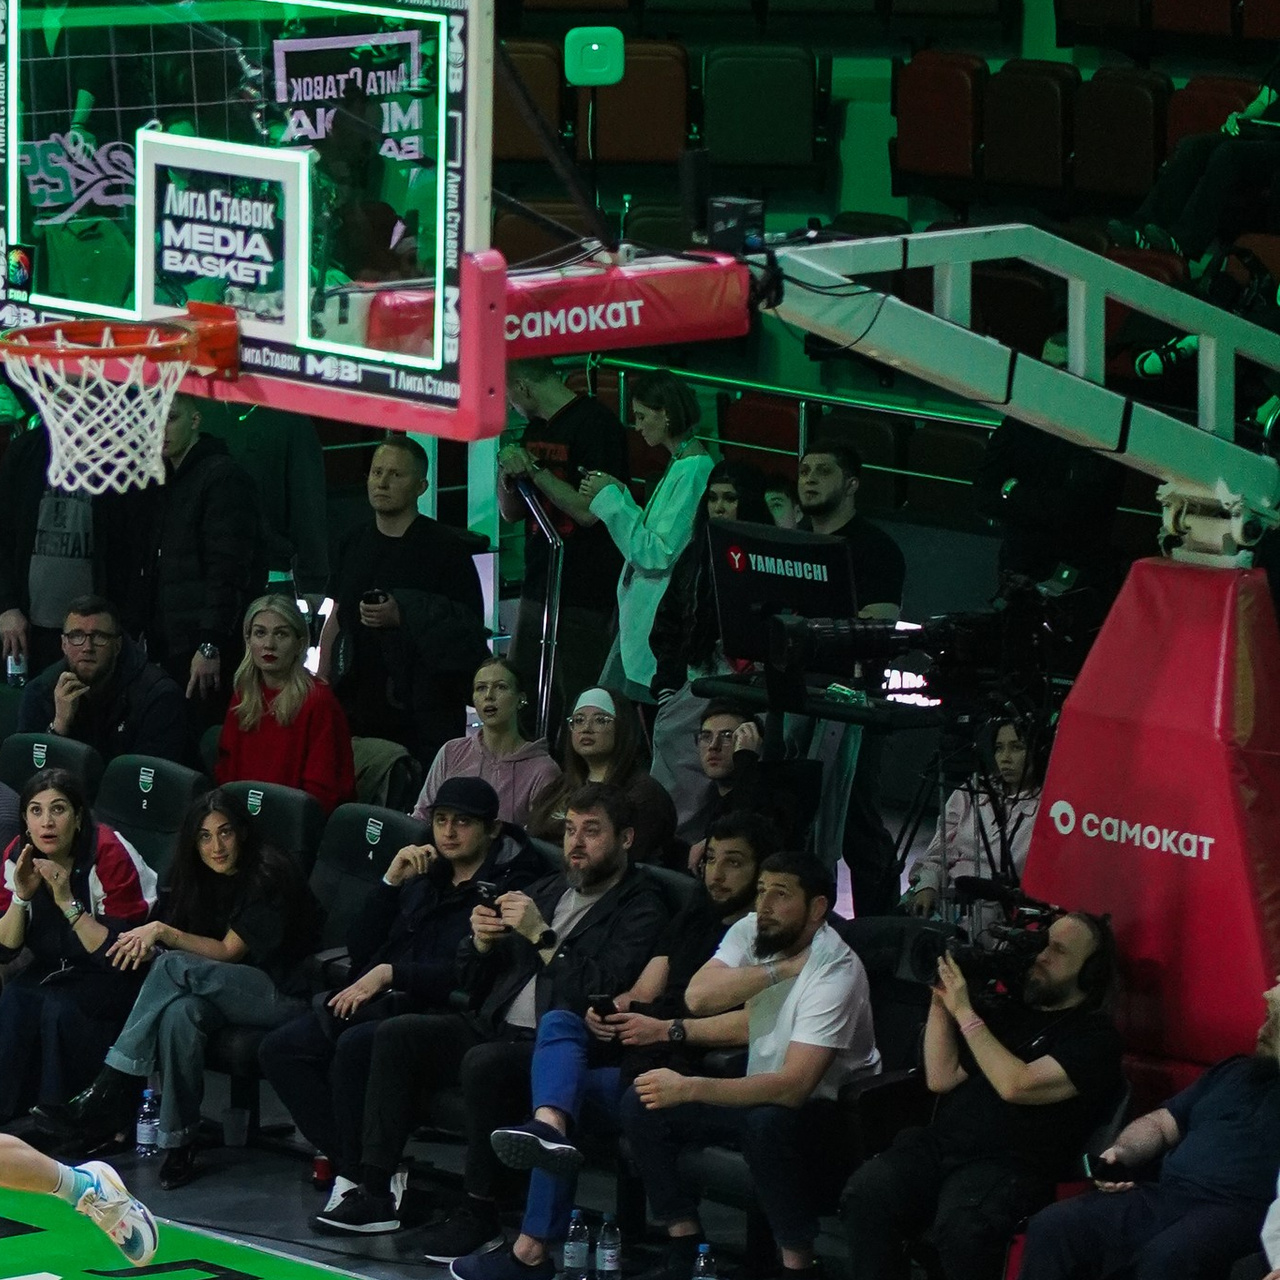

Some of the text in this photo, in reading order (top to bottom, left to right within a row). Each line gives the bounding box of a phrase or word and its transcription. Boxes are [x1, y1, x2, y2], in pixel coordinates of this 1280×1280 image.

[163, 220, 274, 262] MEDIA
[162, 249, 274, 286] BASKET
[504, 299, 645, 341] самокат
[425, 375, 461, 400] СТАВО
[748, 553, 828, 582] YAMAGUCHI
[1081, 813, 1215, 860] самокат
